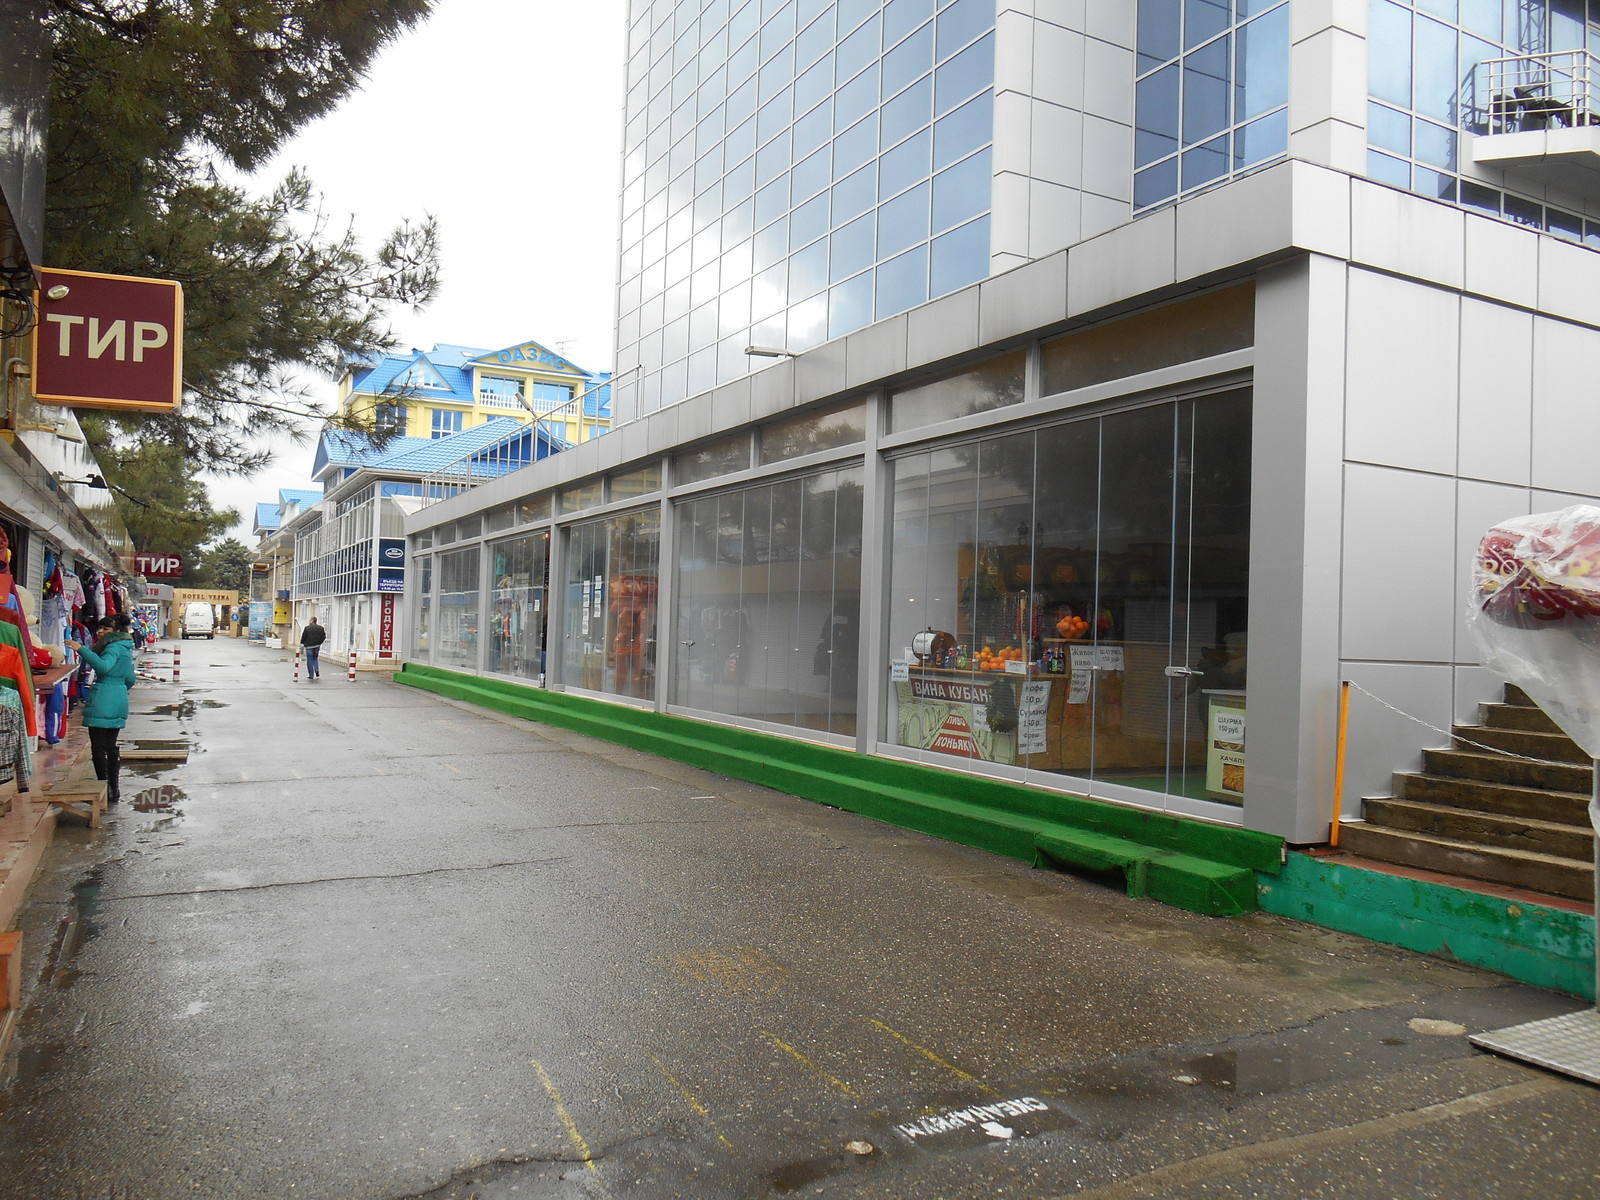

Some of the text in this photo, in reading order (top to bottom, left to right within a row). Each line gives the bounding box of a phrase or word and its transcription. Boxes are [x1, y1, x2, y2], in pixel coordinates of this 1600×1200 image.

[46, 313, 169, 363] ТИР
[497, 347, 567, 370] ОАЗИС
[136, 556, 181, 574] ТИР
[914, 681, 992, 702] ВИНА КУБАН
[946, 715, 966, 727] ПИВО
[1217, 716, 1243, 725] ШАУРМА
[934, 736, 976, 753] КОНЬЯКИ
